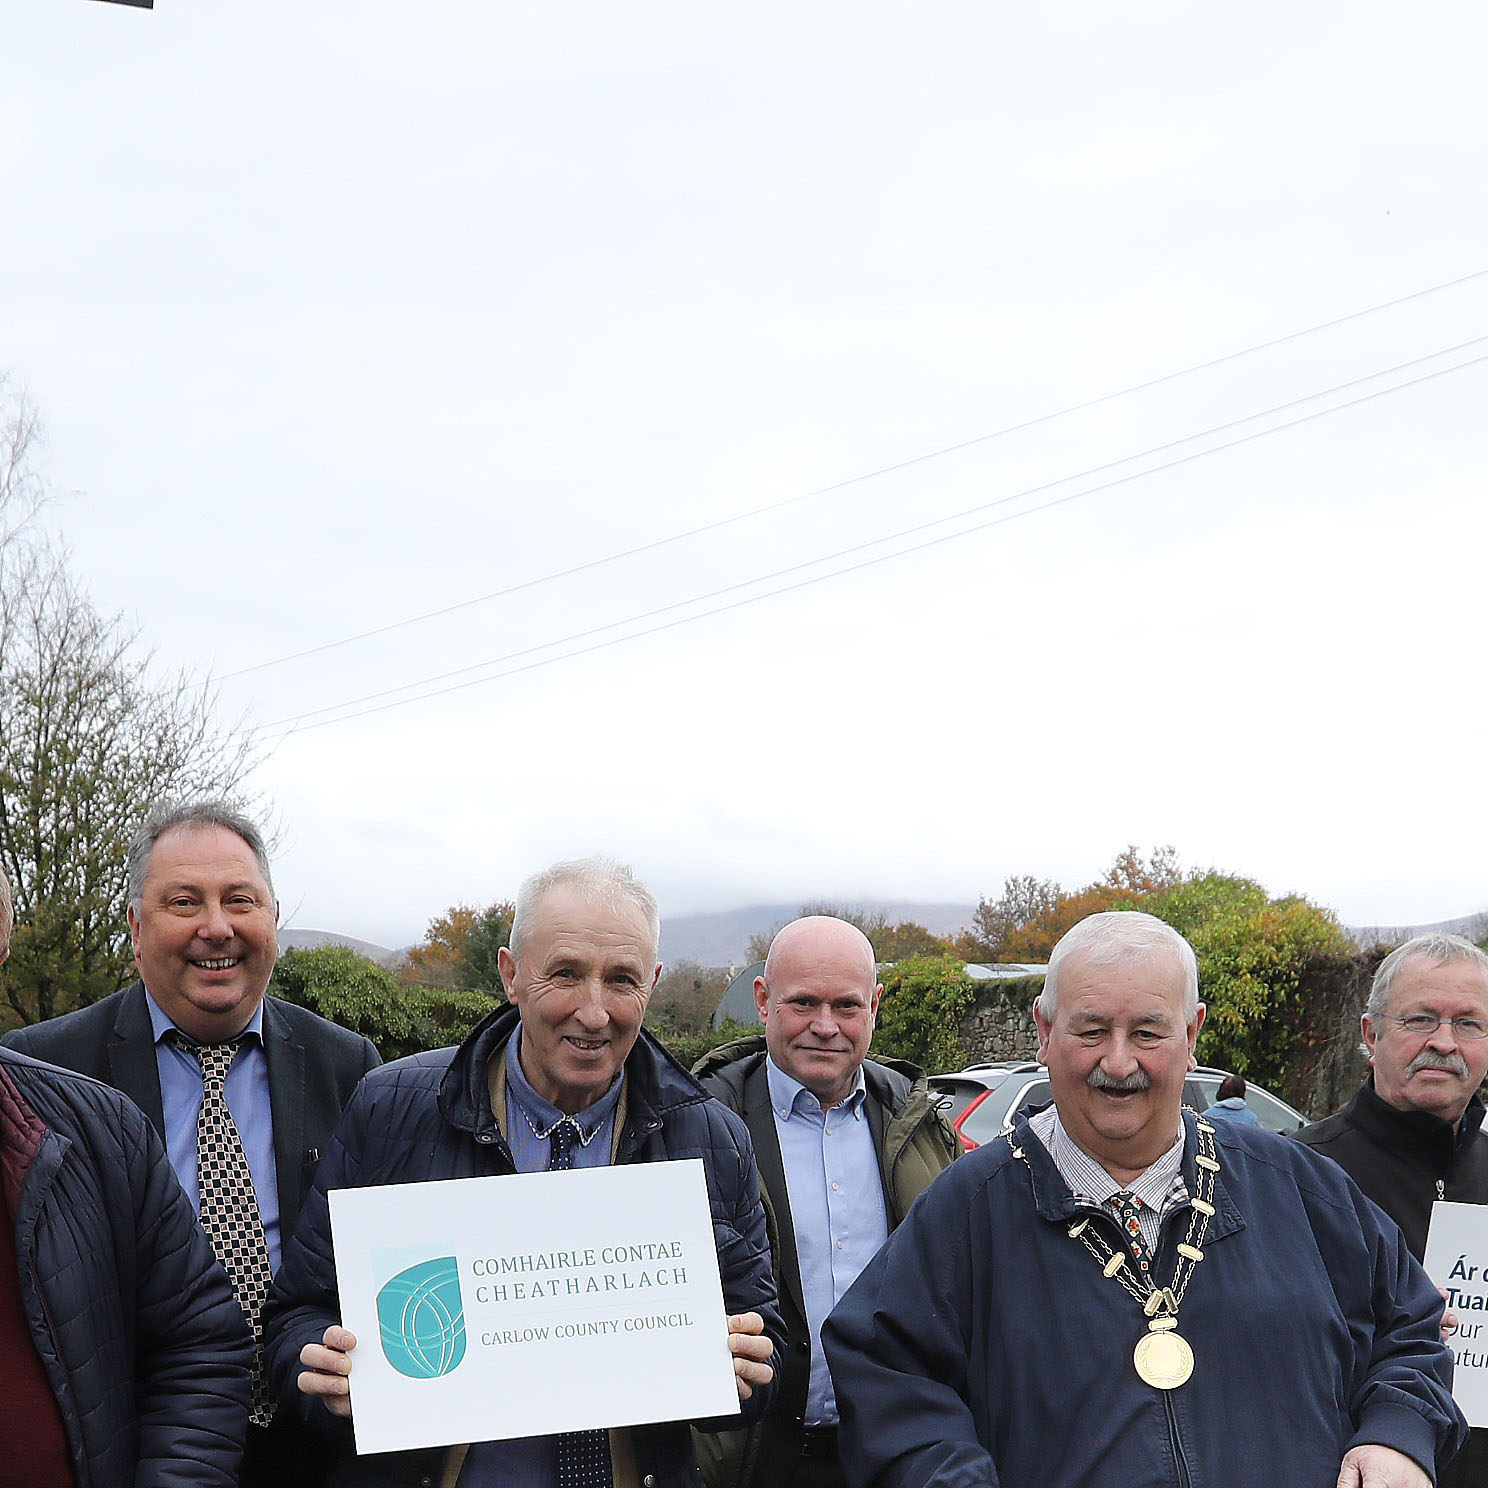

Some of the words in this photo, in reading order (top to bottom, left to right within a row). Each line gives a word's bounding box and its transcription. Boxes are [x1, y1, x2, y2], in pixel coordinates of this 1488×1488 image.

[472, 1250, 596, 1276] COMHAIRLE
[601, 1241, 683, 1264] CONTAE
[1448, 1254, 1479, 1281] Ár
[476, 1267, 688, 1303] CHEATHARLACH
[481, 1327, 550, 1346] CARLOW
[555, 1319, 619, 1339] COUNTY
[624, 1313, 693, 1332] COUNCIL
